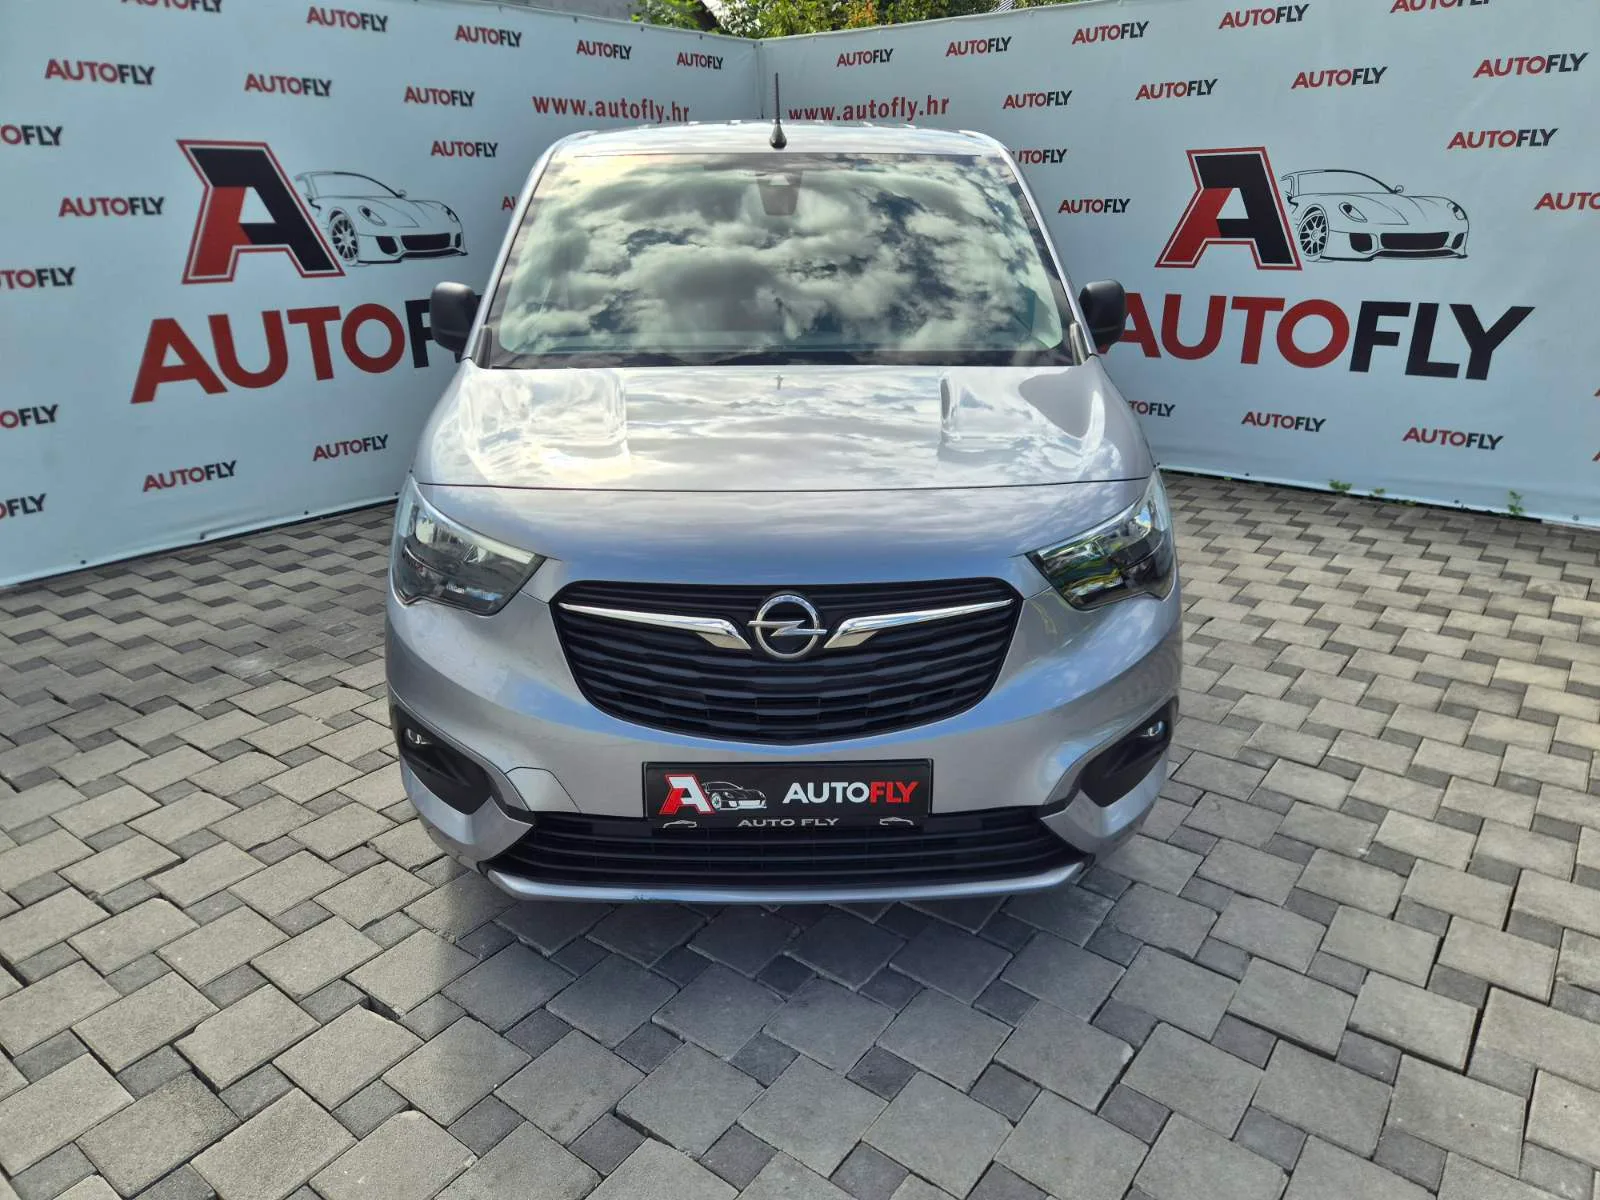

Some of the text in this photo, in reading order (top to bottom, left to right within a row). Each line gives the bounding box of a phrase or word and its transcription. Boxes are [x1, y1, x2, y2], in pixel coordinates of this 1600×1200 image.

[307, 7, 388, 32] AUTOFLY
[1219, 4, 1309, 29] AUTOFLY
[456, 25, 522, 47] AUTOFLY
[1072, 21, 1149, 44] AUTOFLY
[577, 40, 632, 60] AUTOFLY
[946, 36, 1012, 56] AUTOFLY
[677, 52, 723, 70] AUTOFLY
[837, 48, 893, 67] AUTOFLY
[1473, 53, 1588, 78] AUTOFLY
[45, 60, 154, 85] AUTOFLY
[1292, 67, 1387, 89] AUTOFLY
[245, 74, 332, 97] AUTOFLY
[1136, 79, 1218, 100] AUTOFLY
[404, 87, 474, 107] AUTOFLY
[789, 95, 949, 121] www.autofly.hr
[1003, 90, 1072, 109] AUTOFLY
[533, 97, 689, 123] www.autofly.hr
[431, 141, 498, 157] AUTOFLY
[1448, 128, 1559, 149] AUTOFLY
[59, 197, 164, 216] AUTOFLY
[1058, 199, 1130, 213] AUTOFLY
[0, 267, 75, 288] TOFLY
[1098, 292, 1535, 381] AUTOFLY
[130, 295, 482, 404] AUTOF
[1241, 412, 1326, 432] AUTOFLY
[313, 434, 388, 461] AUTOFLY
[1403, 428, 1503, 450] AUTOFLY
[143, 460, 236, 492] AUTOFLY
[782, 781, 920, 804] AUTOFLY
[737, 818, 839, 828] AUTO FLY
